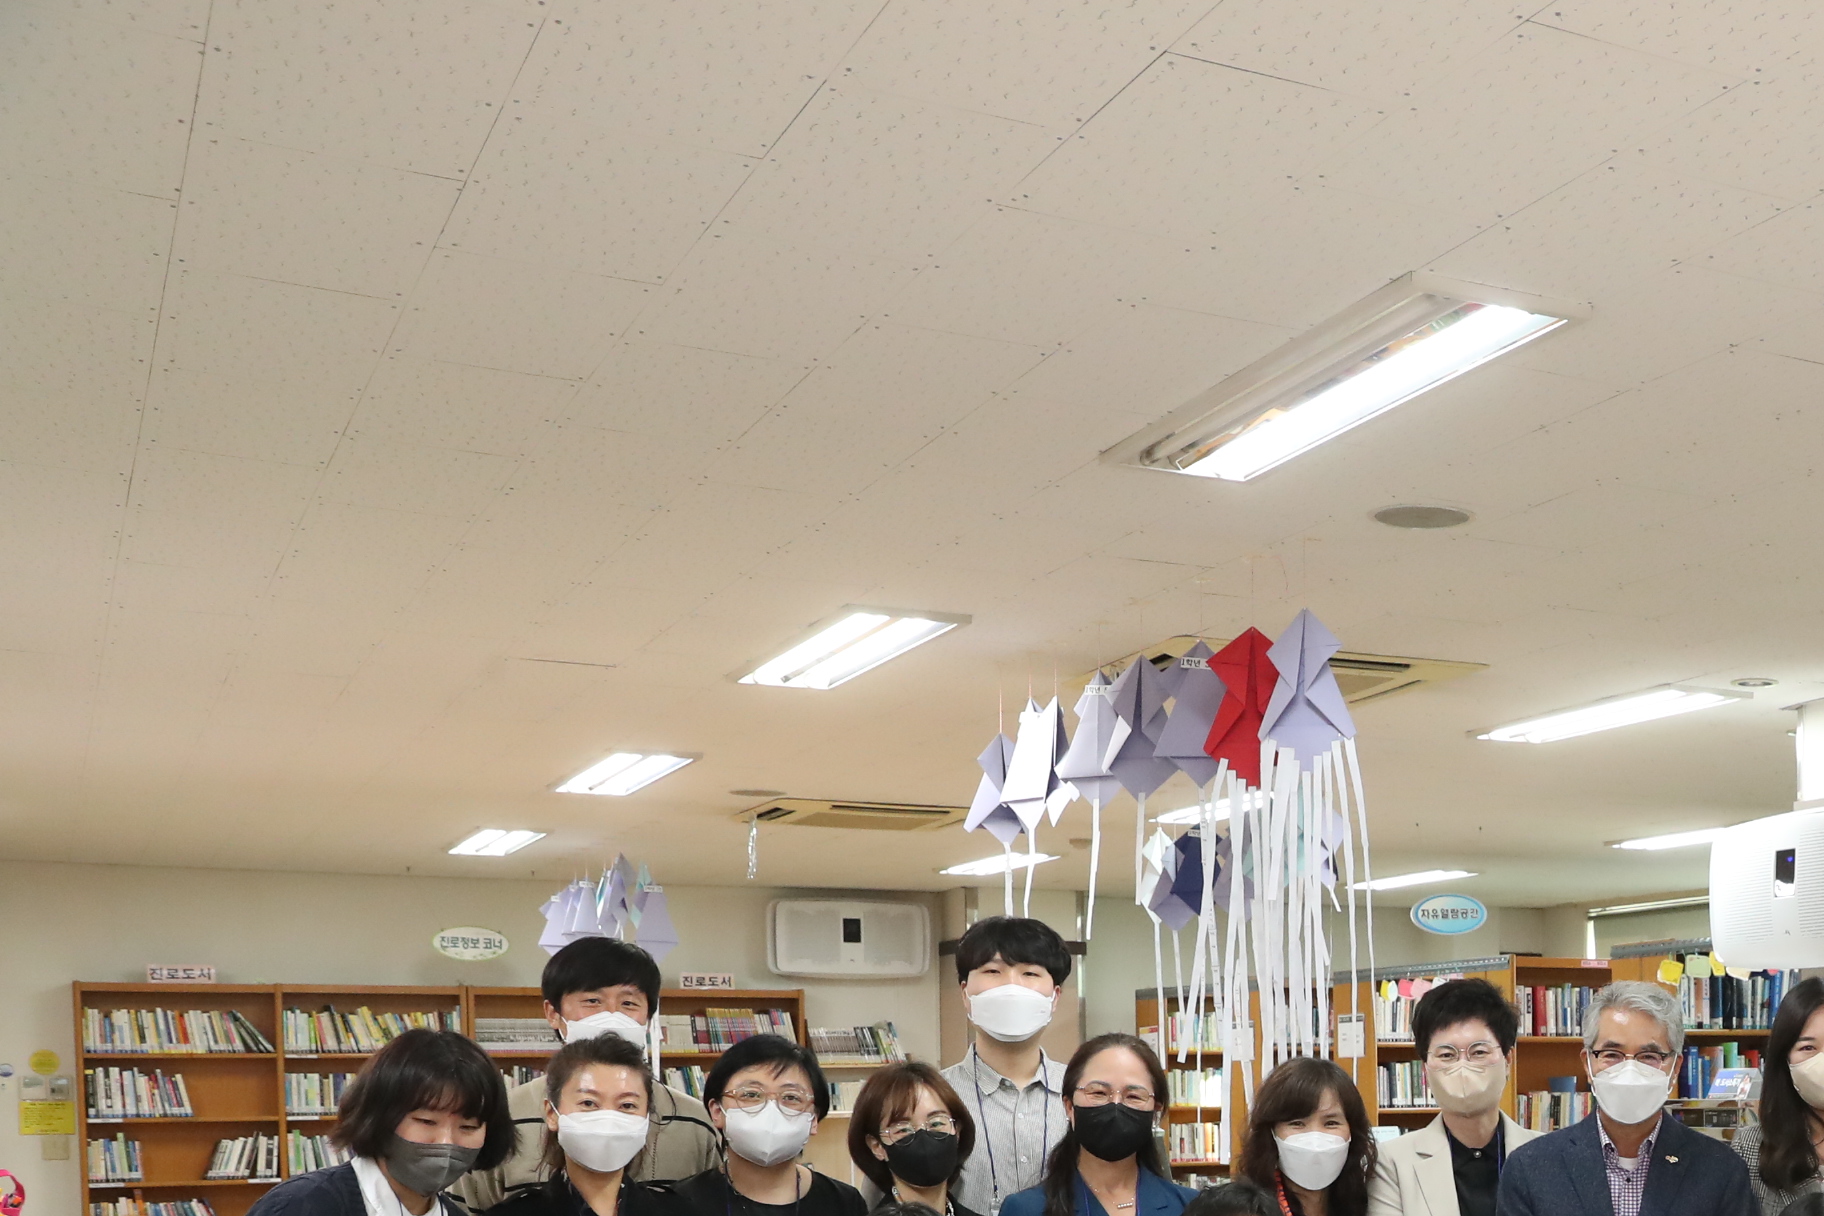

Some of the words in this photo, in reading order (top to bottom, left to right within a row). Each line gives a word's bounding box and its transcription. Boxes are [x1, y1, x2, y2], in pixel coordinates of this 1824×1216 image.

[1181, 658, 1201, 668] 1학년
[1421, 908, 1478, 919] 자유열람공간
[440, 936, 480, 949] 진로정보
[483, 938, 502, 949] 코너
[149, 967, 211, 980] 진로도서
[682, 976, 731, 987] 진로도서
